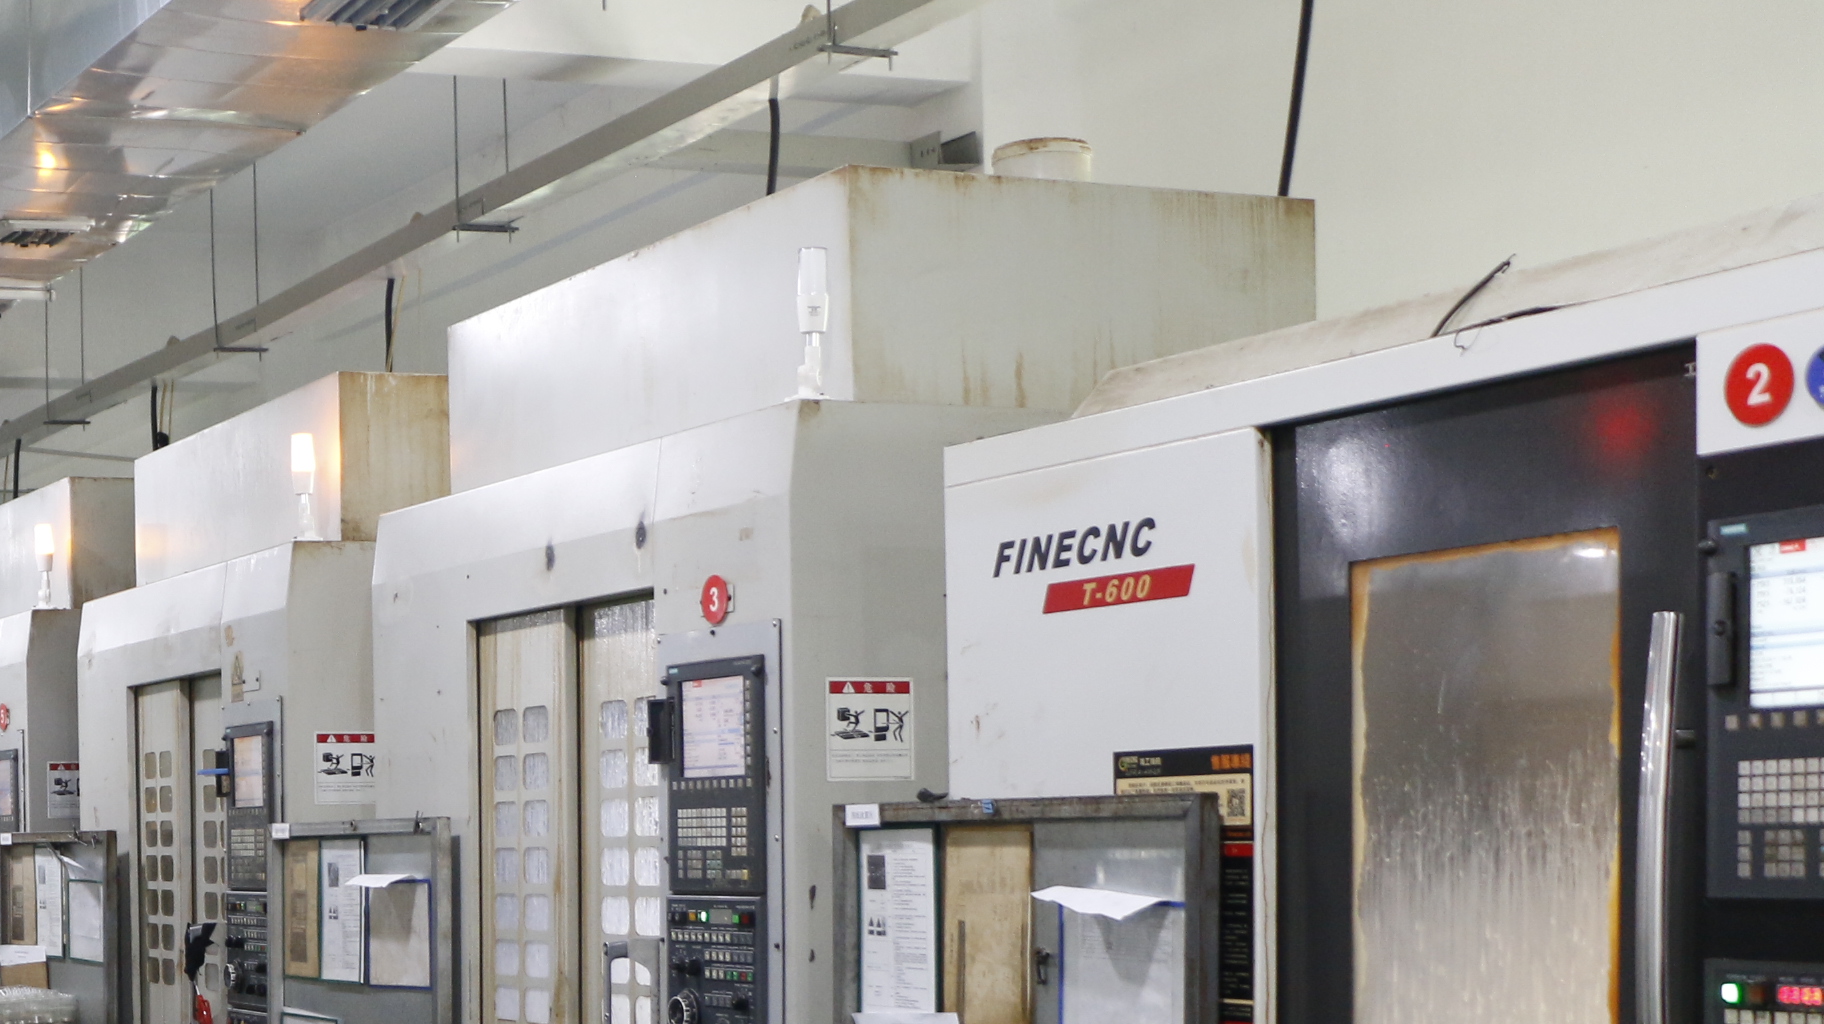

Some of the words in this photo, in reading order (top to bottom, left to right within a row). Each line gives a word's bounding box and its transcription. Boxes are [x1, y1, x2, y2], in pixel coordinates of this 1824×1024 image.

[1745, 362, 1773, 406] 2
[992, 516, 1156, 578] FINECNC
[709, 587, 719, 612] 3
[1082, 574, 1152, 606] T-600
